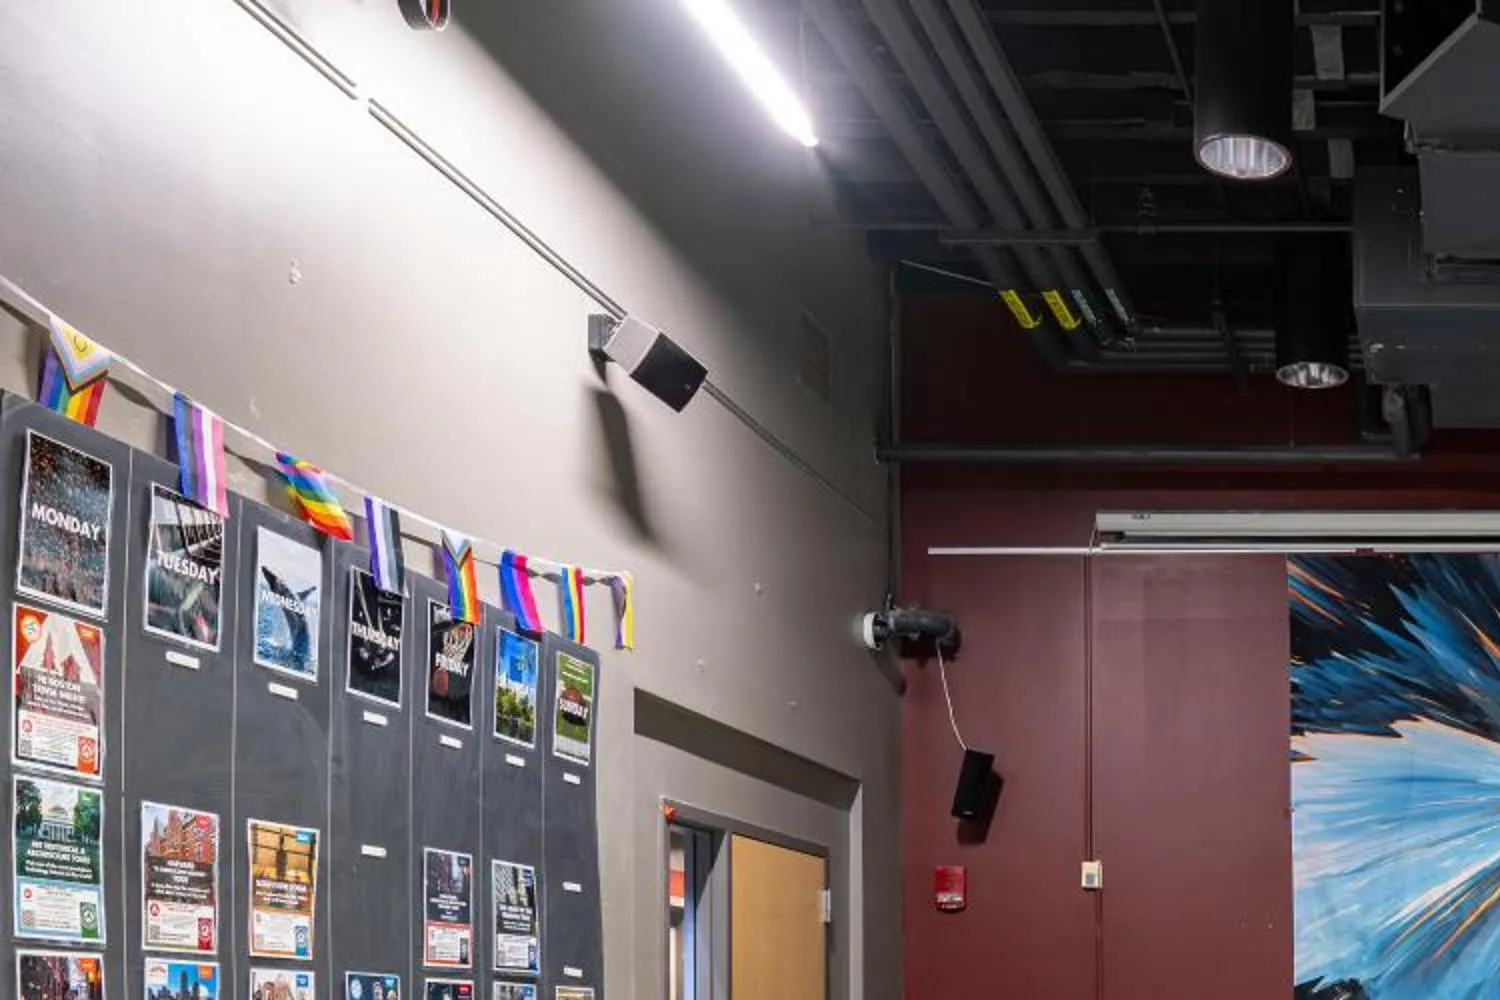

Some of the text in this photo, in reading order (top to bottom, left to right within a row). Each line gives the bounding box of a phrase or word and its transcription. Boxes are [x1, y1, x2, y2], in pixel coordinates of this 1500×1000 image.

[31, 503, 101, 541] MONDAY
[156, 550, 220, 583] TUESDAY
[351, 621, 401, 650] THURSDAY
[435, 653, 470, 677] FRIDAY
